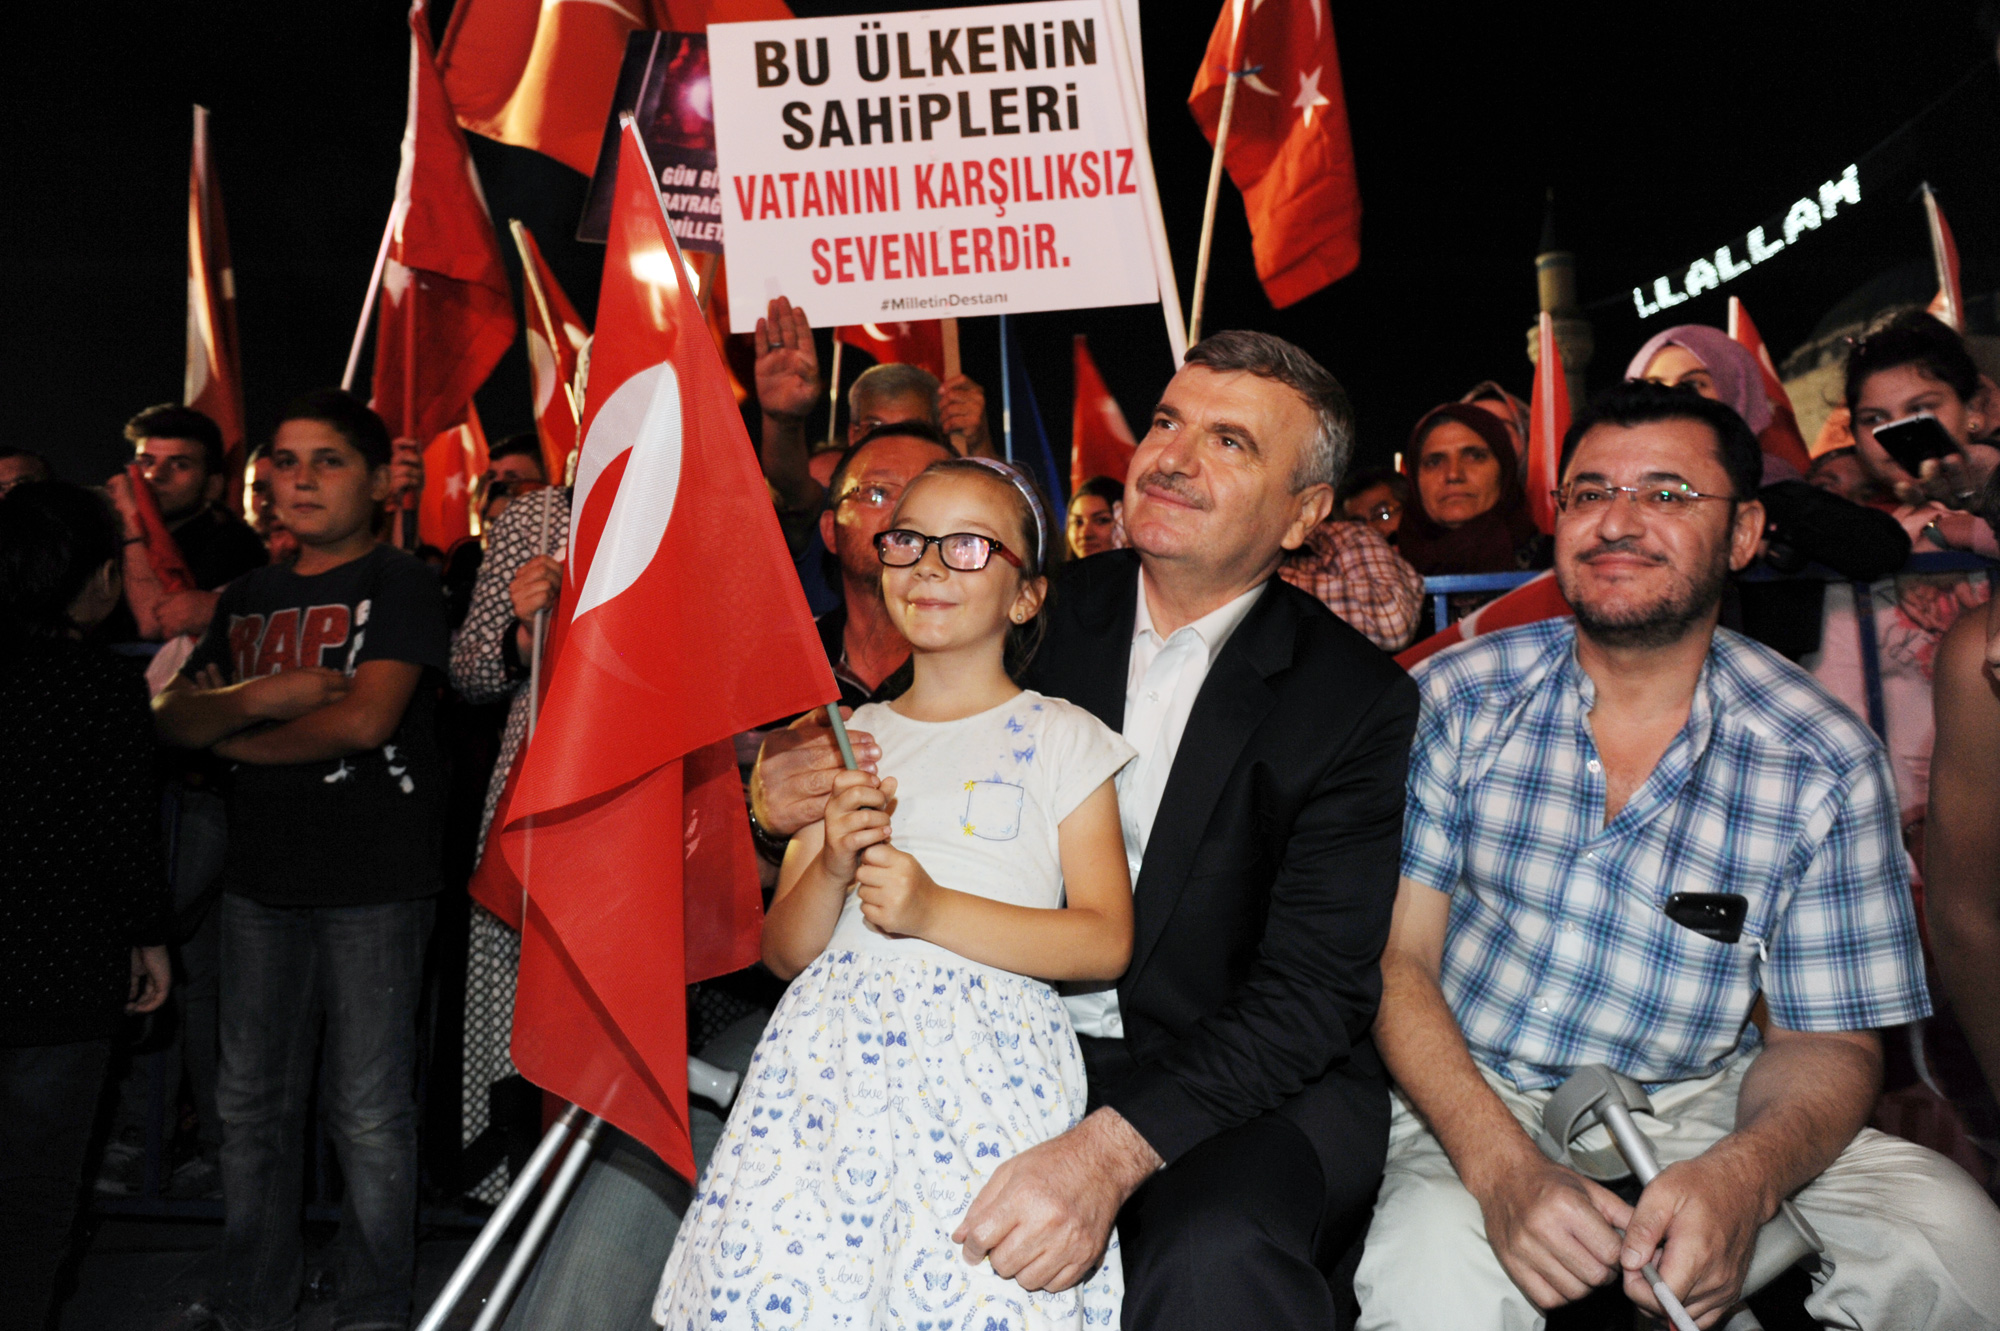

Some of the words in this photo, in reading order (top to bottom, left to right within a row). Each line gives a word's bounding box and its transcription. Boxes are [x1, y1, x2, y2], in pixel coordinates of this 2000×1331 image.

[754, 37, 830, 88] BU
[661, 164, 698, 188] GÜN
[733, 166, 901, 221] VATANINI
[915, 148, 1138, 218] KARŞILIKSIZ
[925, 1011, 948, 1029] love
[852, 1081, 884, 1100] love
[928, 1182, 955, 1201] love
[832, 1265, 864, 1285] love
